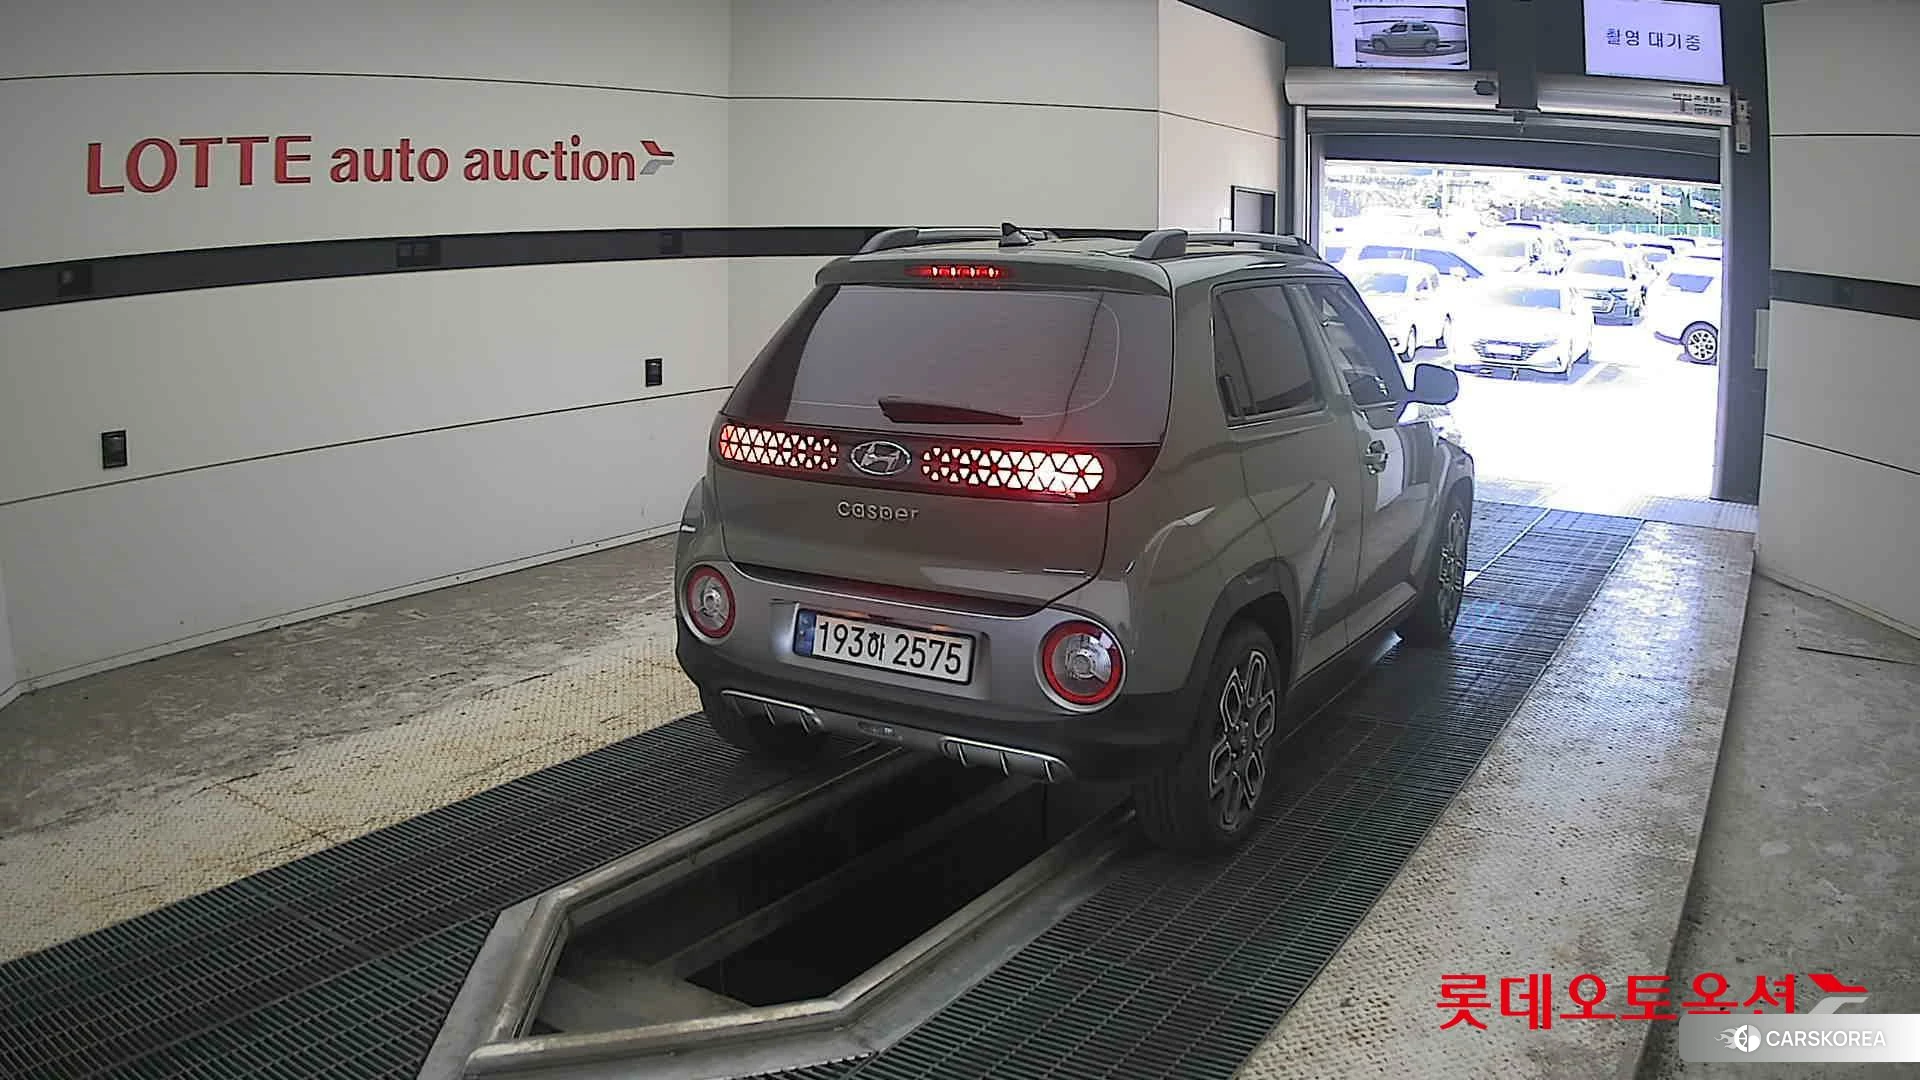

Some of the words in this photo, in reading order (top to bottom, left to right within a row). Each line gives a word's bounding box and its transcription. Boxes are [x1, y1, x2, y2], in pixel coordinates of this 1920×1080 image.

[1648, 32, 1701, 51] 대기중
[87, 136, 312, 194] LOTTE
[329, 138, 449, 182] auto
[463, 135, 636, 181] auction
[892, 633, 963, 675] 2575
